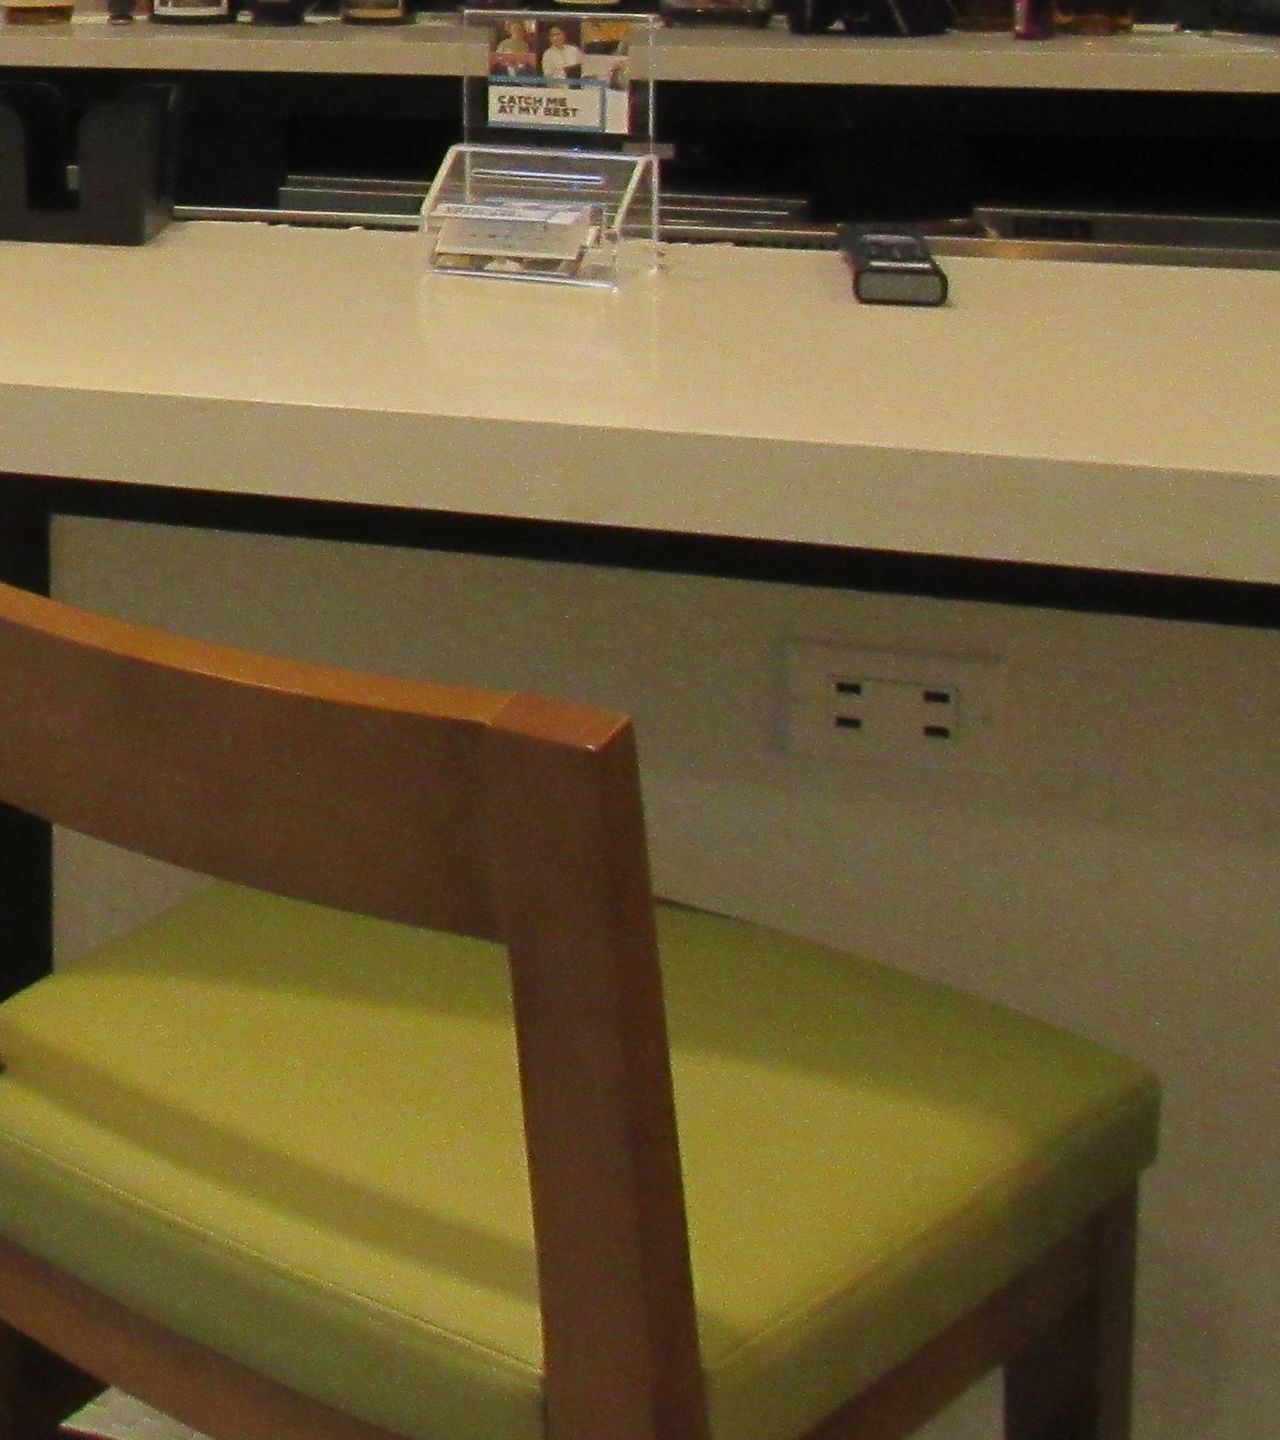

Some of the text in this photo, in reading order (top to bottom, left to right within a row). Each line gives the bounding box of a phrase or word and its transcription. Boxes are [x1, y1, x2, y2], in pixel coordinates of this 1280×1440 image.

[497, 95, 568, 108] CATCH ME
[497, 105, 579, 118] AT MY BEST
